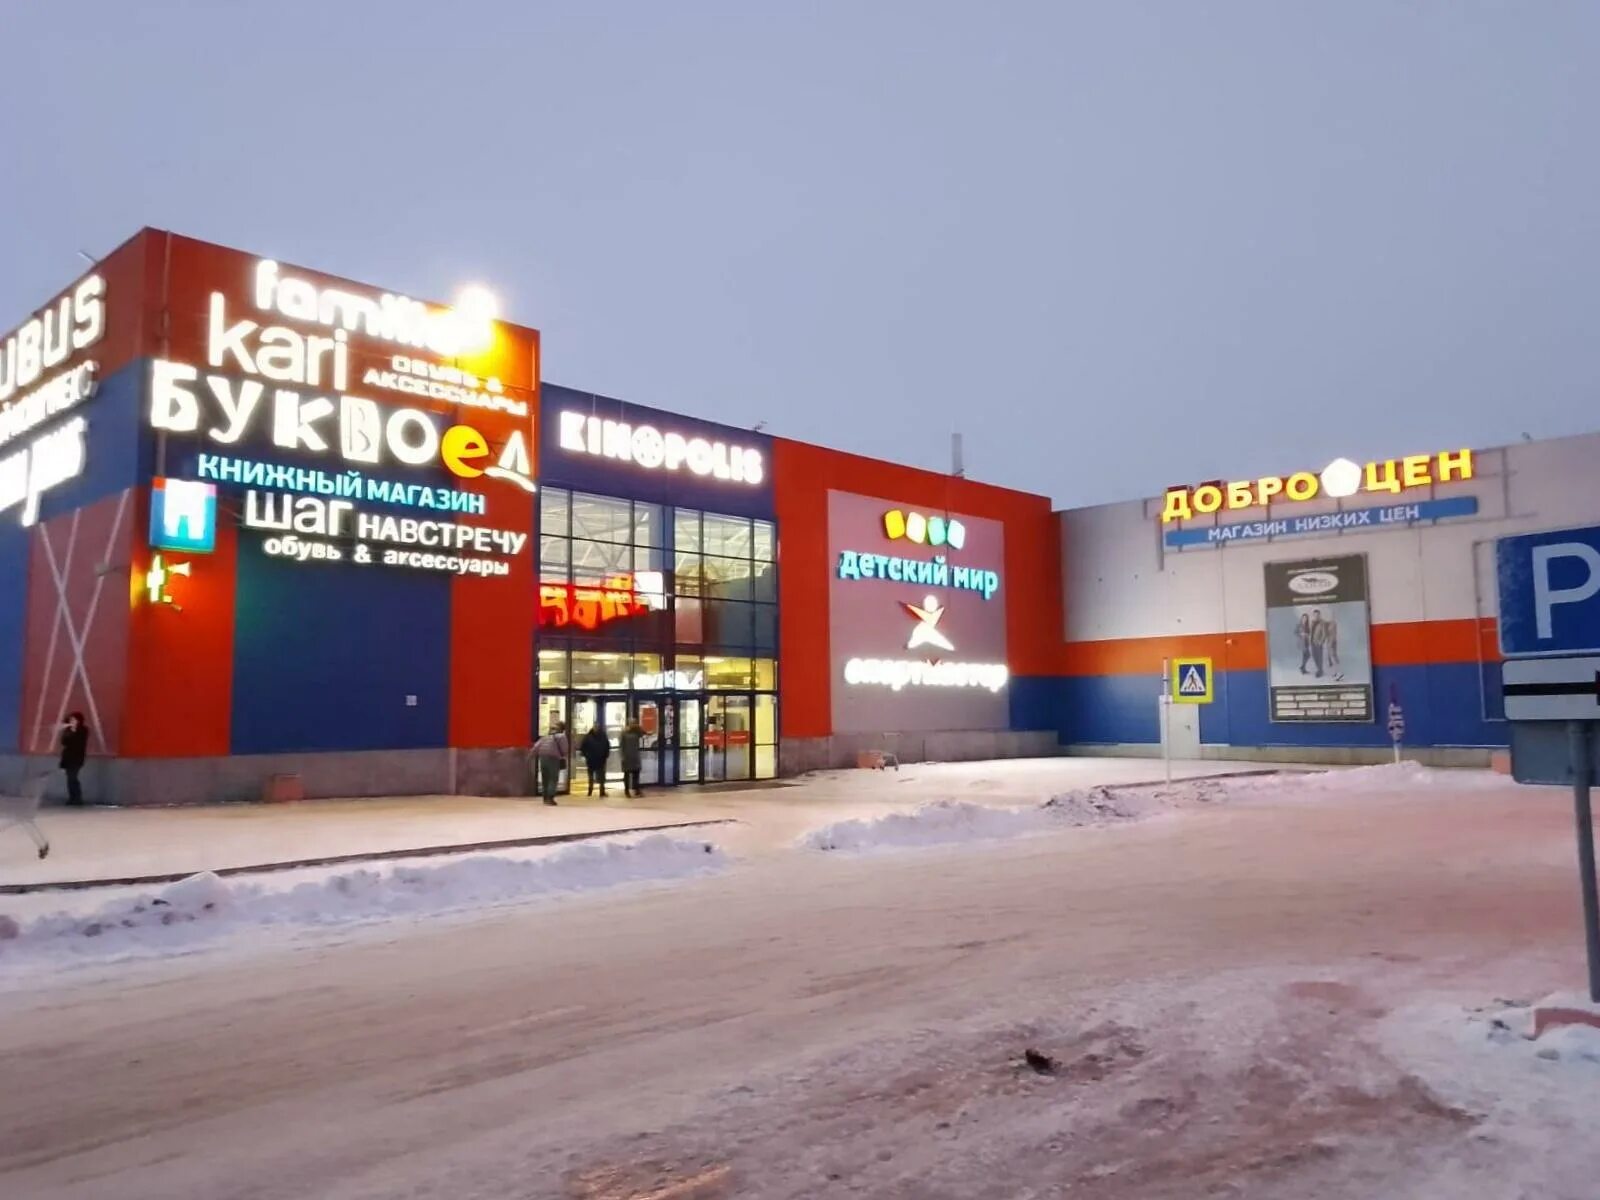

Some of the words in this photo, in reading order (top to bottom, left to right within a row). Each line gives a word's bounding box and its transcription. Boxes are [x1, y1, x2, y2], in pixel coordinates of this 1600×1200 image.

[208, 292, 347, 391] kari
[559, 411, 763, 484] KINOPOLIS
[198, 453, 363, 499] КНИЖНЫЙ
[366, 478, 486, 515] МАГАЗИН
[358, 513, 527, 555] НАВСТРЕЧУ
[1207, 519, 1288, 542] МАГАЗИН
[1295, 508, 1370, 531] НИЗКИХ
[1379, 504, 1420, 522] ЦЕН
[263, 536, 341, 561] обувь
[353, 544, 372, 563] &
[383, 551, 510, 577] аксессуары
[953, 565, 999, 600] мир
